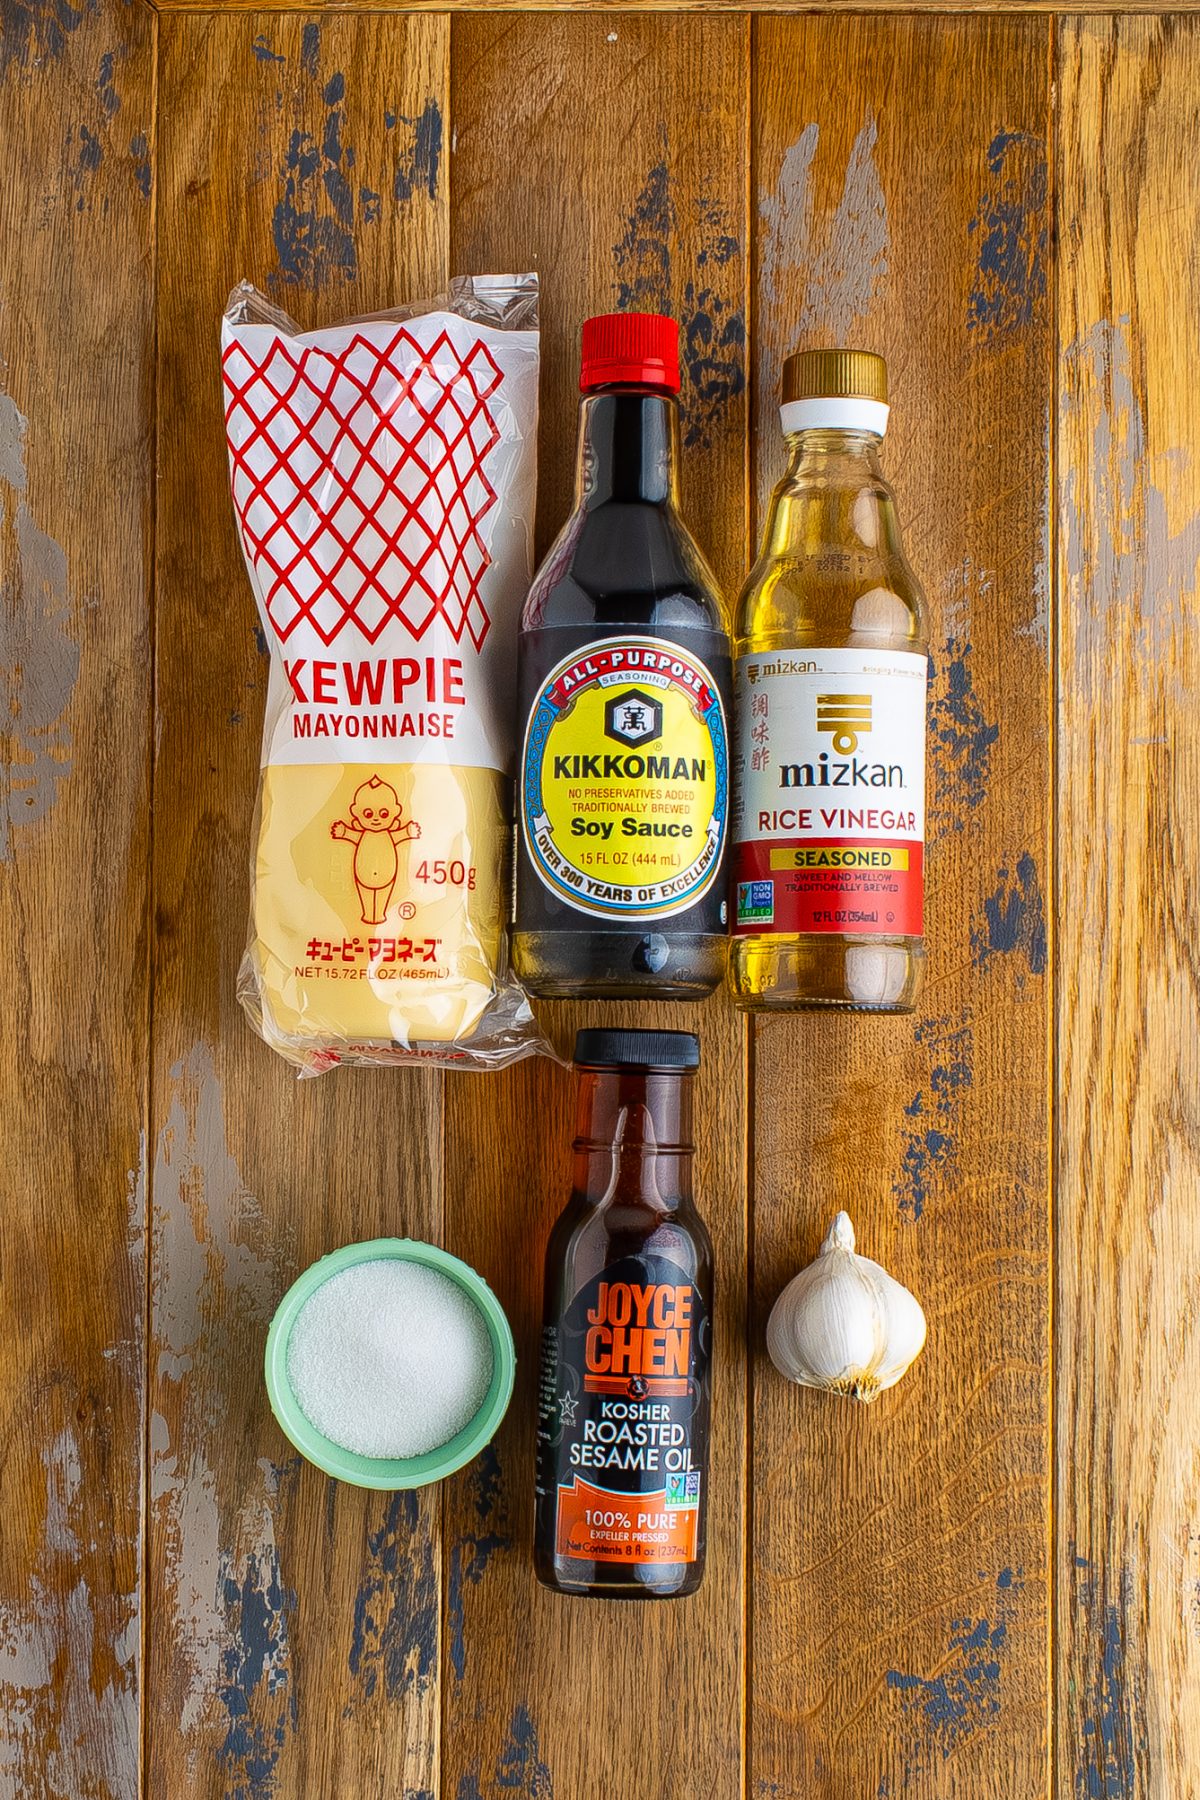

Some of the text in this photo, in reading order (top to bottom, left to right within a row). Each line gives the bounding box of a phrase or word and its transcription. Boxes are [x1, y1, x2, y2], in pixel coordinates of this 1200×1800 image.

[562, 651, 703, 692] ALL-PURPOSE
[762, 658, 817, 676] mizkan
[283, 657, 466, 706] KEWPIE
[601, 672, 668, 687] SEASONING
[293, 713, 454, 738] MAYONNAISE
[554, 755, 706, 781] KIKKOMAN
[778, 752, 904, 788] mizkan
[568, 788, 695, 800] NO PRESERVATIVES ADDED
[572, 802, 691, 814] TRADITIONALLY BREWED
[570, 817, 693, 840] Soy Sauce
[758, 809, 916, 832] RICE VINEGAR
[537, 834, 717, 902] OVER 300 YEARS OF EXCELLENCE
[580, 852, 681, 866] 15 FL OZ (444 mL)
[794, 851, 892, 867] SEASONED
[415, 860, 477, 890] 450g
[794, 873, 892, 881] SWEET AND MELLOW
[753, 883, 771, 892] NON
[753, 891, 771, 900] GMO
[785, 883, 899, 892] TRADITIONALLY BREWED
[813, 911, 822, 922] 12
[823, 911, 833, 922] FL
[835, 911, 847, 922] OZ
[294, 966, 450, 980] NET 15.72 FL OZ (465mL)
[587, 1282, 692, 1329] JOYCE
[585, 1326, 690, 1376] CHEN
[601, 1401, 671, 1421] KOSHER
[583, 1420, 685, 1446] ROASTED
[569, 1443, 694, 1472] SESAME OIL
[584, 1510, 677, 1530] 100% PURE
[590, 1530, 669, 1543] EXPELLER PRESSED
[566, 1538, 581, 1551] Net
[582, 1541, 623, 1555] Contents
[625, 1545, 632, 1556] 8
[643, 1549, 656, 1557] oz
